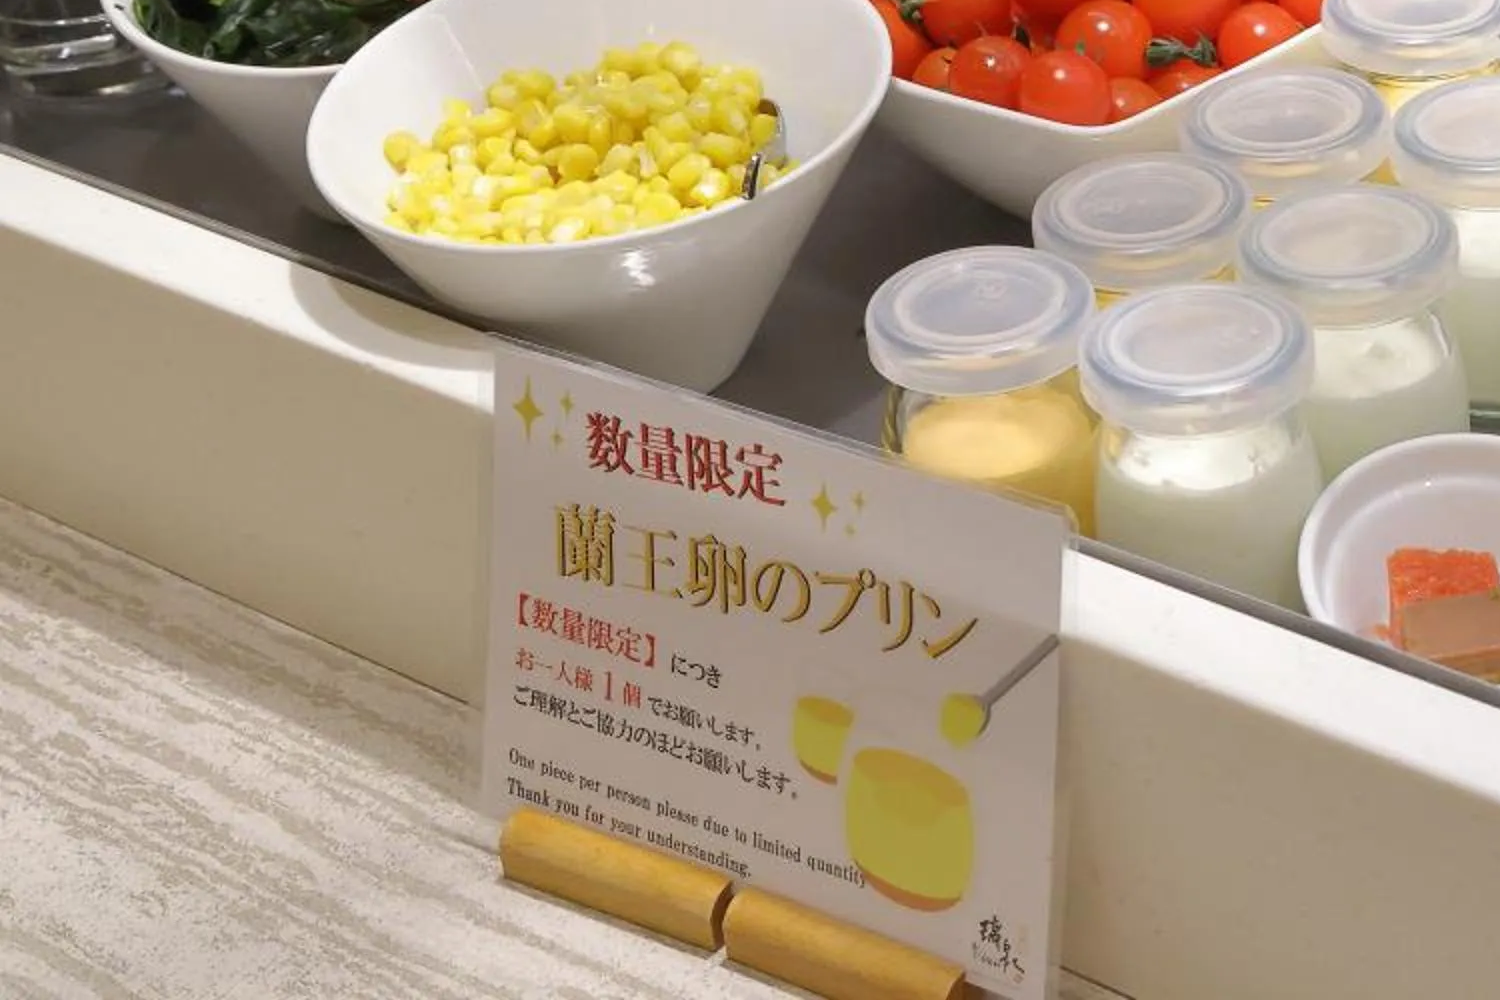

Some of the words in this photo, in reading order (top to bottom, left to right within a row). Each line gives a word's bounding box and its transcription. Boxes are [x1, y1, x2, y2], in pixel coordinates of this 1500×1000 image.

[585, 411, 787, 507] 数量限定
[553, 503, 978, 660] 蘭王卵のプリン
[507, 776, 550, 807] Thank
[555, 799, 579, 817] you
[585, 805, 604, 825] for
[610, 817, 642, 838] your
[509, 748, 535, 768] One
[540, 761, 575, 783] piece
[579, 775, 601, 793] per
[607, 784, 651, 811] person
[656, 800, 700, 827] please
[703, 815, 730, 837] due
[735, 827, 748, 844] to
[753, 831, 801, 863] limited
